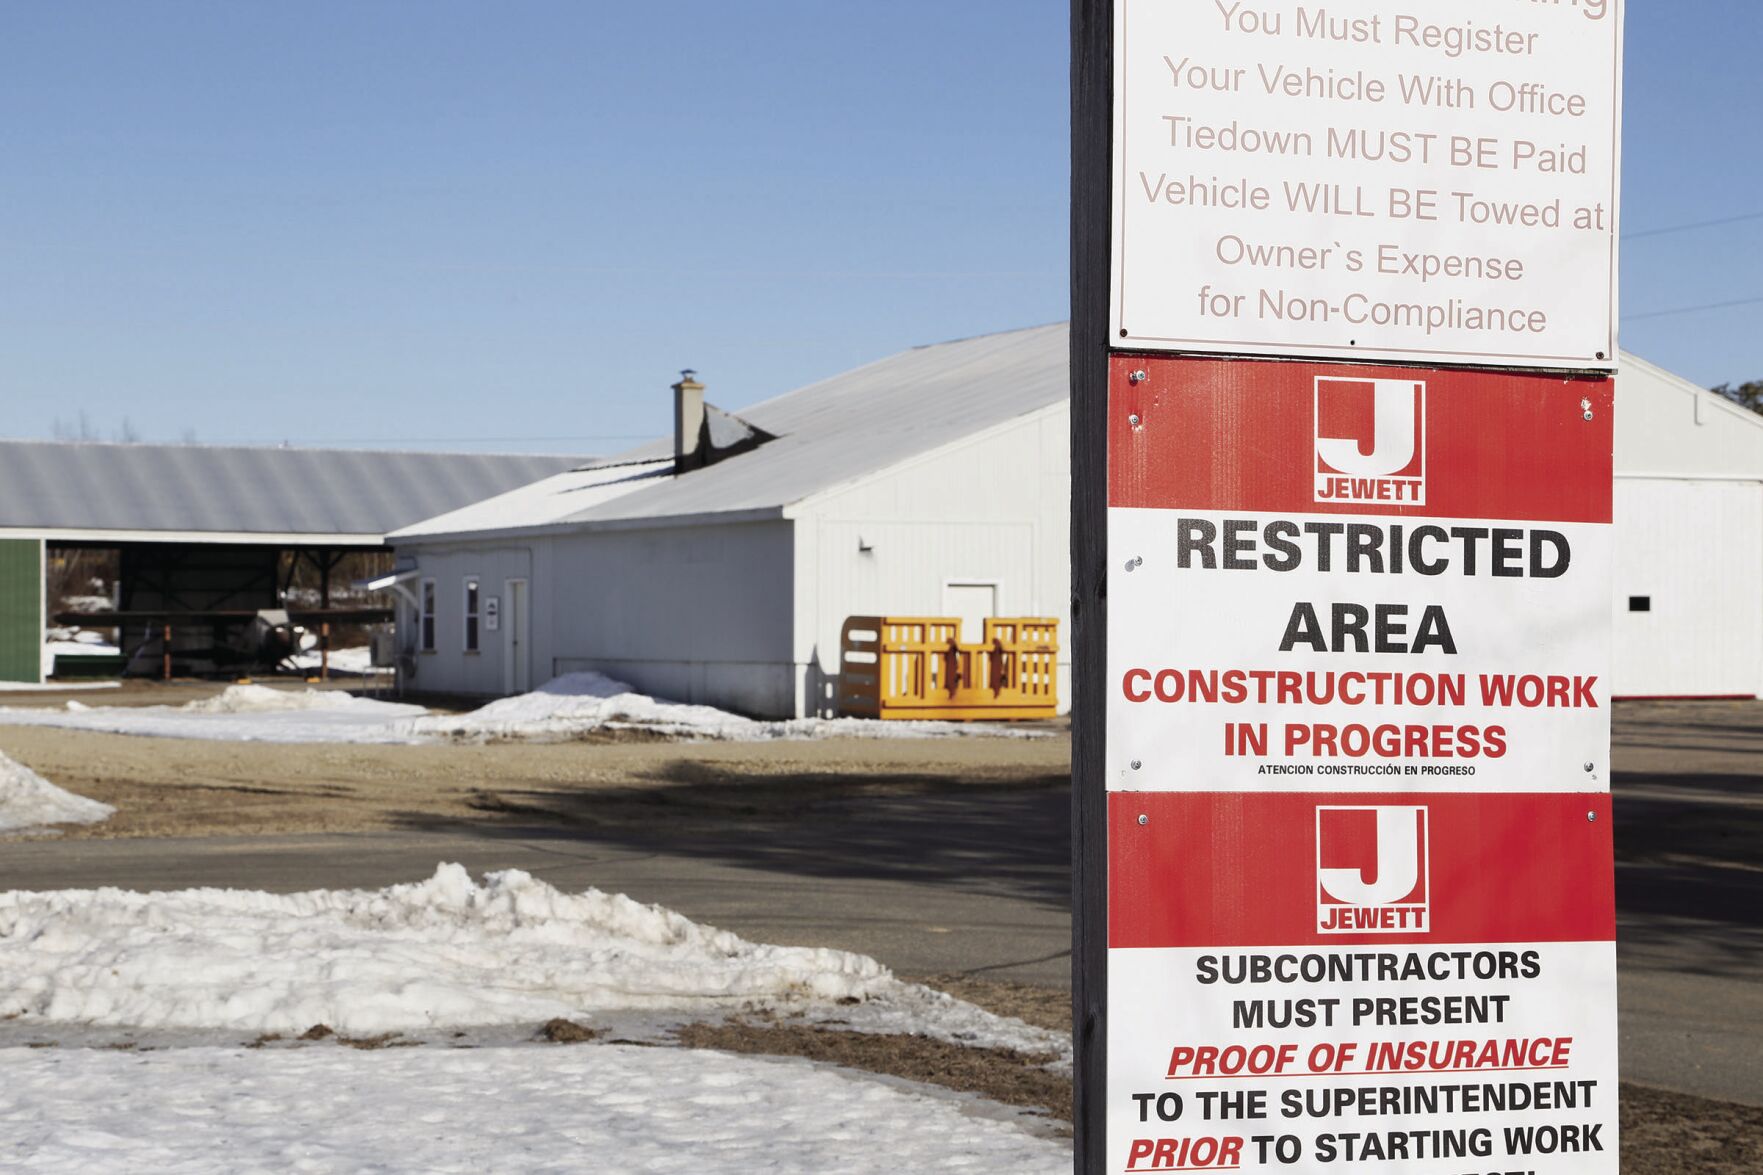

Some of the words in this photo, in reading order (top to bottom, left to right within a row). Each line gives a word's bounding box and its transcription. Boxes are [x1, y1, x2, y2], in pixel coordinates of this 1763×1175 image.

[1215, 0, 1280, 35] You
[1297, 7, 1381, 43] Must
[1395, 15, 1538, 57] Register
[1163, 56, 1246, 91] Your
[1258, 64, 1384, 102] Vehicle
[1398, 74, 1474, 108] With
[1489, 81, 1585, 116] Office
[1162, 116, 1311, 155] Tiedown
[1328, 128, 1437, 164] MUST
[1451, 136, 1498, 168] BE
[1513, 141, 1586, 174] Paid
[1139, 172, 1269, 210] Vehicle
[1283, 181, 1374, 216] WILL
[1390, 188, 1437, 220] BE
[1451, 192, 1559, 227] Towed
[1573, 203, 1604, 230] at
[1378, 245, 1523, 282] Expense
[1198, 285, 1245, 317] for
[1259, 289, 1546, 335] Non-Compliance
[1317, 478, 1422, 500] JEWETT
[1178, 519, 1570, 578] RESTRICTED
[1279, 603, 1457, 654] AREA
[1123, 669, 1465, 705] CONSTRUCTION
[1479, 675, 1598, 707] WORK
[1225, 723, 1267, 756] IN
[1285, 724, 1506, 758] PROGRESS
[1257, 764, 1314, 775] ATENCION
[1317, 763, 1401, 775] CONSTRUCCIÓN
[1404, 765, 1418, 776] EN
[1421, 765, 1476, 776] PROGRESO
[1320, 908, 1426, 928] JEWETT
[1197, 951, 1540, 984] SUBCONTRACTORS
[1234, 999, 1340, 1028] MUST
[1353, 995, 1510, 1026] PRESENT
[1168, 1043, 1298, 1075] PROOF
[1307, 1044, 1356, 1071] OF
[1365, 1038, 1572, 1069] INSURANCE
[1132, 1092, 1183, 1121] TO
[1196, 1091, 1266, 1120] THE
[1281, 1081, 1597, 1118] SUPERINTENDENT
[1128, 1138, 1243, 1168] PRIOR
[1252, 1135, 1301, 1164] TO
[1315, 1128, 1492, 1162] STARTING
[1504, 1124, 1603, 1155] WORK
